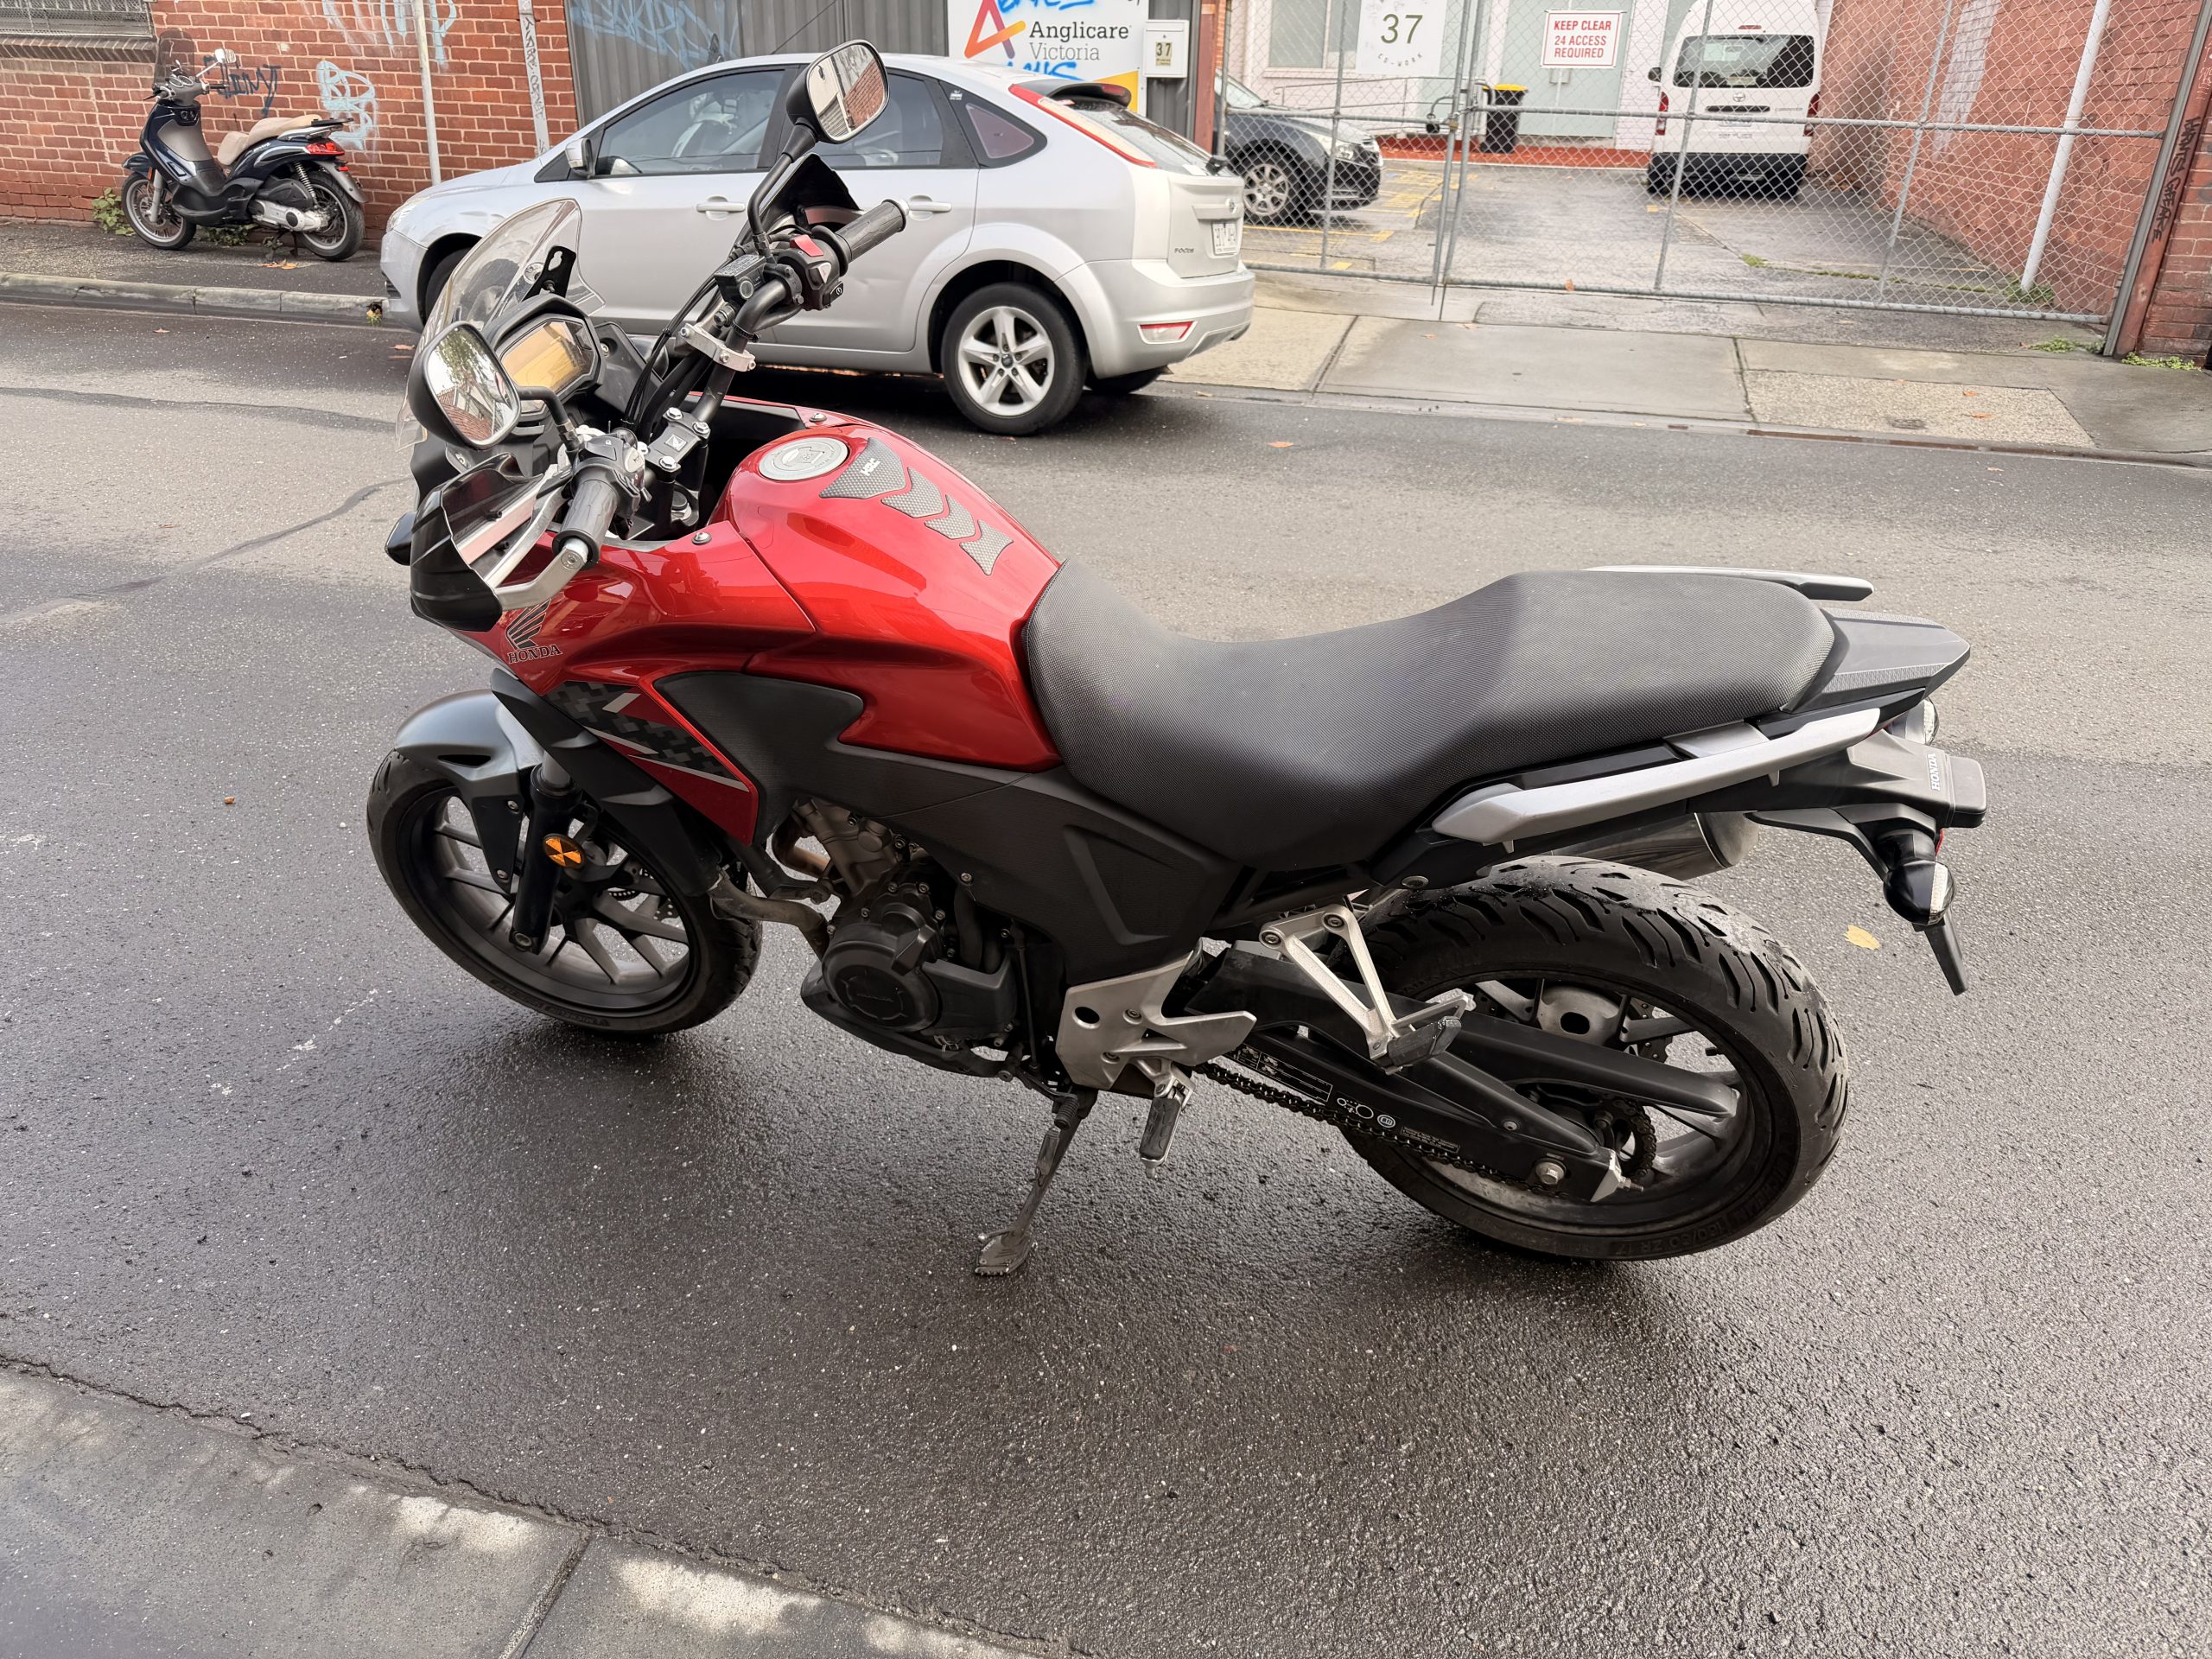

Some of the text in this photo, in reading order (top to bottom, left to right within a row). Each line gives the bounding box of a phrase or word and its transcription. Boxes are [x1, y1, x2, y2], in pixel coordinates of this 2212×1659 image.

[1029, 21, 1129, 42] Anglicare
[1381, 14, 1423, 44] 37
[1554, 21, 1611, 30] KEEP CLEAR
[1156, 42, 1171, 56] 37
[1554, 35, 1606, 46] 24 ACCESS
[1029, 42, 1099, 60] Victoria
[1554, 48, 1604, 58] REQUIRED
[508, 645, 563, 664] HONDA
[1927, 753, 1941, 791] HONDA
